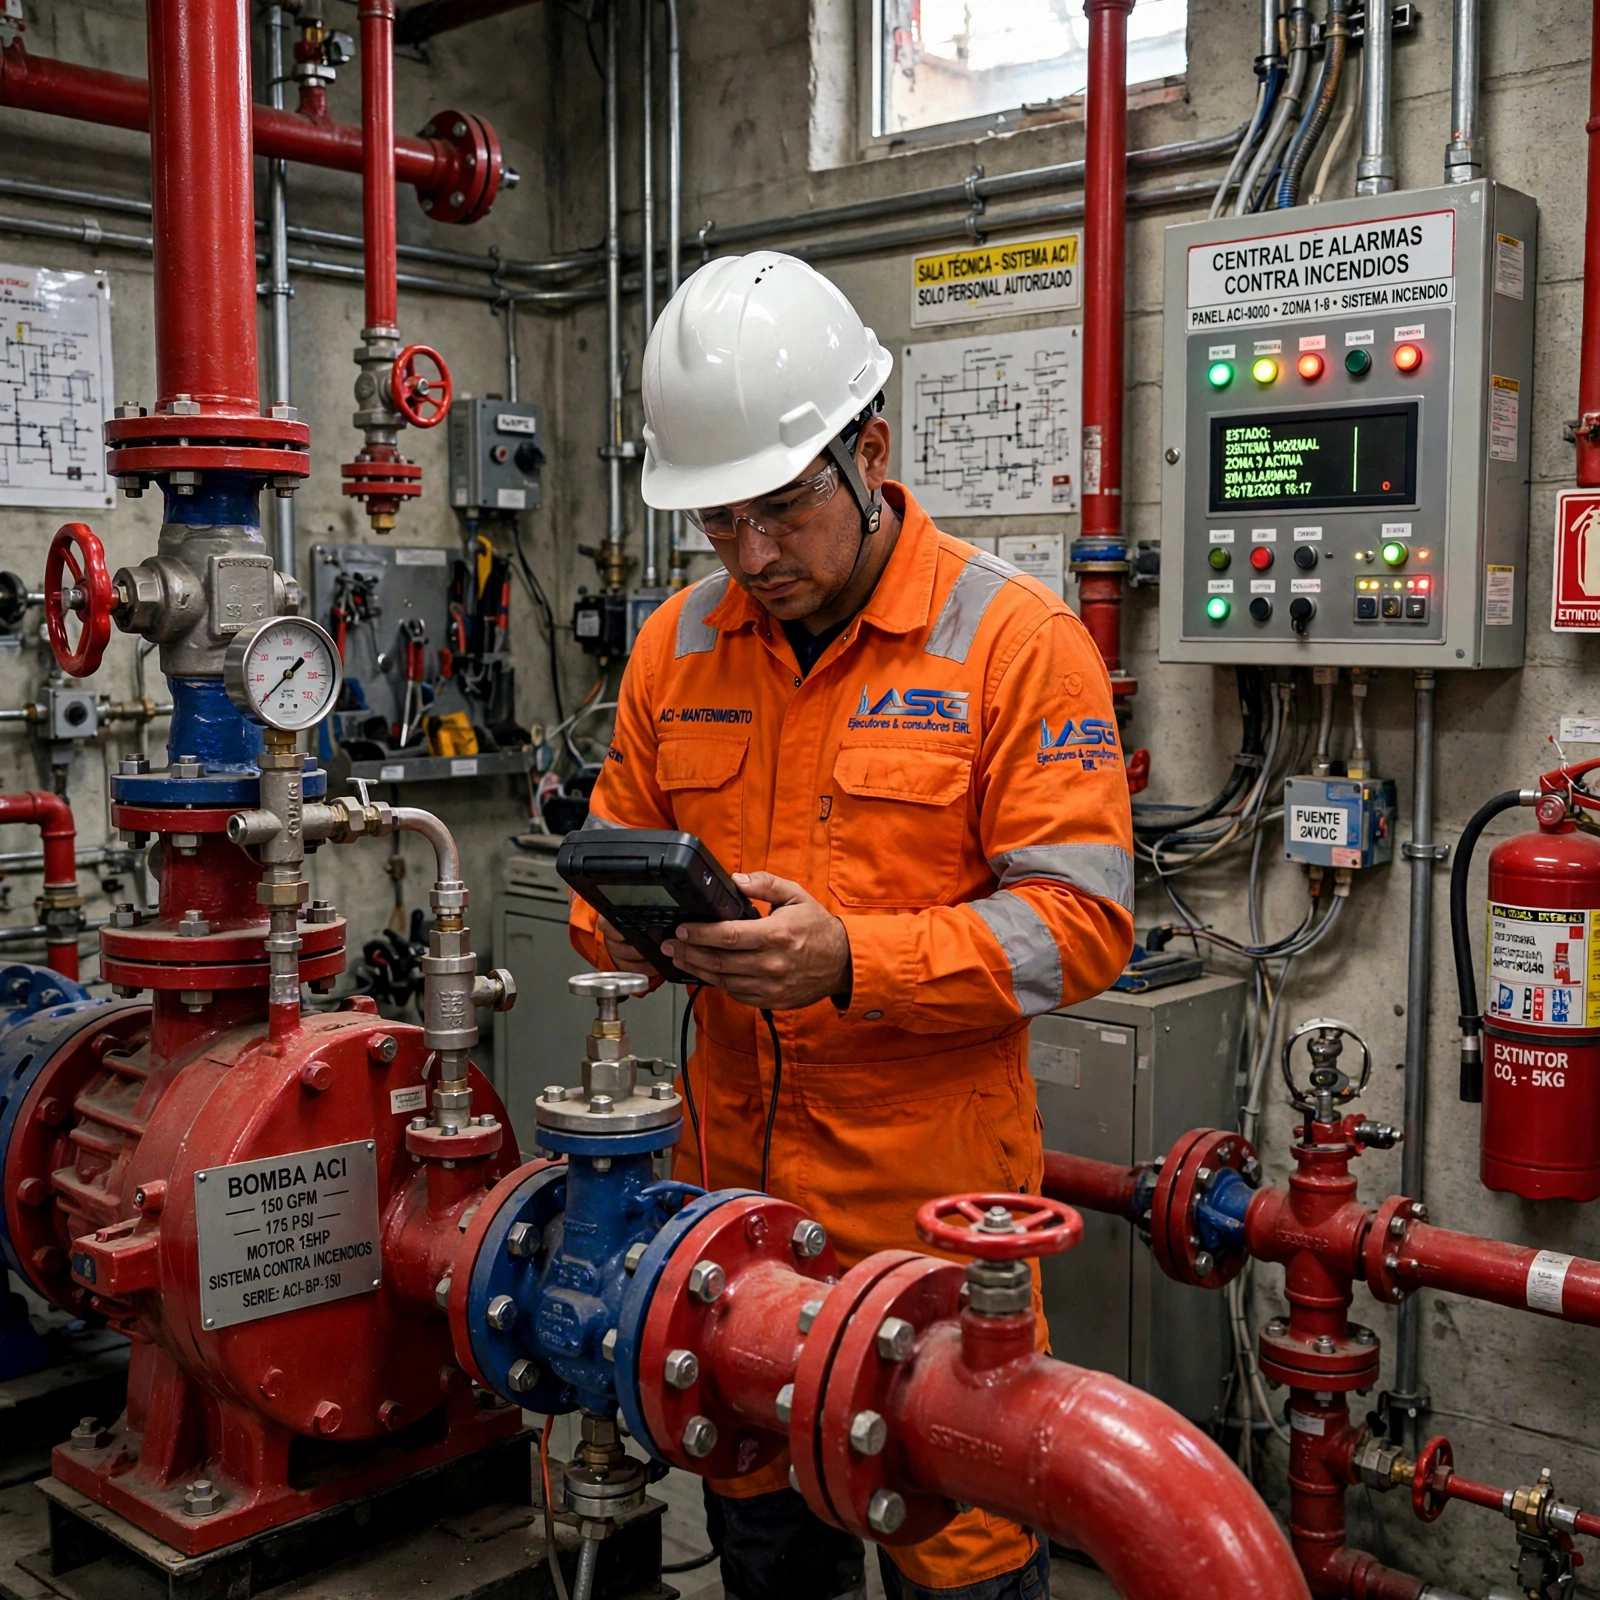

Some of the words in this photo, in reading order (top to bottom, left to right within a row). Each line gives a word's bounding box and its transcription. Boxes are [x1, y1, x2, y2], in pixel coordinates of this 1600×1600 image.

[1213, 244, 1294, 271] CENTRAL
[1300, 239, 1324, 260] DE
[1328, 226, 1423, 257] ALARMAS
[918, 264, 945, 282] SALA
[947, 253, 992, 279] TÉCNICA
[1001, 248, 1048, 270] SISTEMA
[1051, 244, 1069, 263] ACI
[1225, 268, 1299, 295] CONTRA
[1305, 254, 1409, 286] INCENDIOS
[918, 287, 945, 306] SOLO
[947, 278, 1001, 302] PERSONAL
[1004, 269, 1072, 295] AUTORIZADO
[1192, 310, 1225, 326] PANEL
[1281, 299, 1311, 315] ZONA
[1341, 290, 1389, 309] SISTEMA
[1392, 283, 1448, 303] INCENDIO
[1226, 427, 1271, 441] ESTADO:
[659, 709, 674, 722] ACI
[680, 708, 753, 724] MANTENIMIENTO
[868, 688, 970, 720] ASG
[893, 719, 899, 729] &
[1297, 810, 1341, 825] FUENTE
[1494, 1043, 1568, 1069] EXTINTOR
[1532, 1069, 1565, 1088] 5KG
[228, 1165, 307, 1199] BOMBA
[313, 1157, 347, 1182] ACI
[260, 1197, 283, 1215] 150
[265, 1218, 287, 1235] 175
[292, 1212, 314, 1231] PSI
[247, 1237, 295, 1261] MOTOR
[209, 1267, 261, 1290] SISTEMA
[263, 1255, 310, 1279] CONTRA
[313, 1241, 372, 1267] INCENDIOS
[242, 1289, 280, 1308] SERIE:
